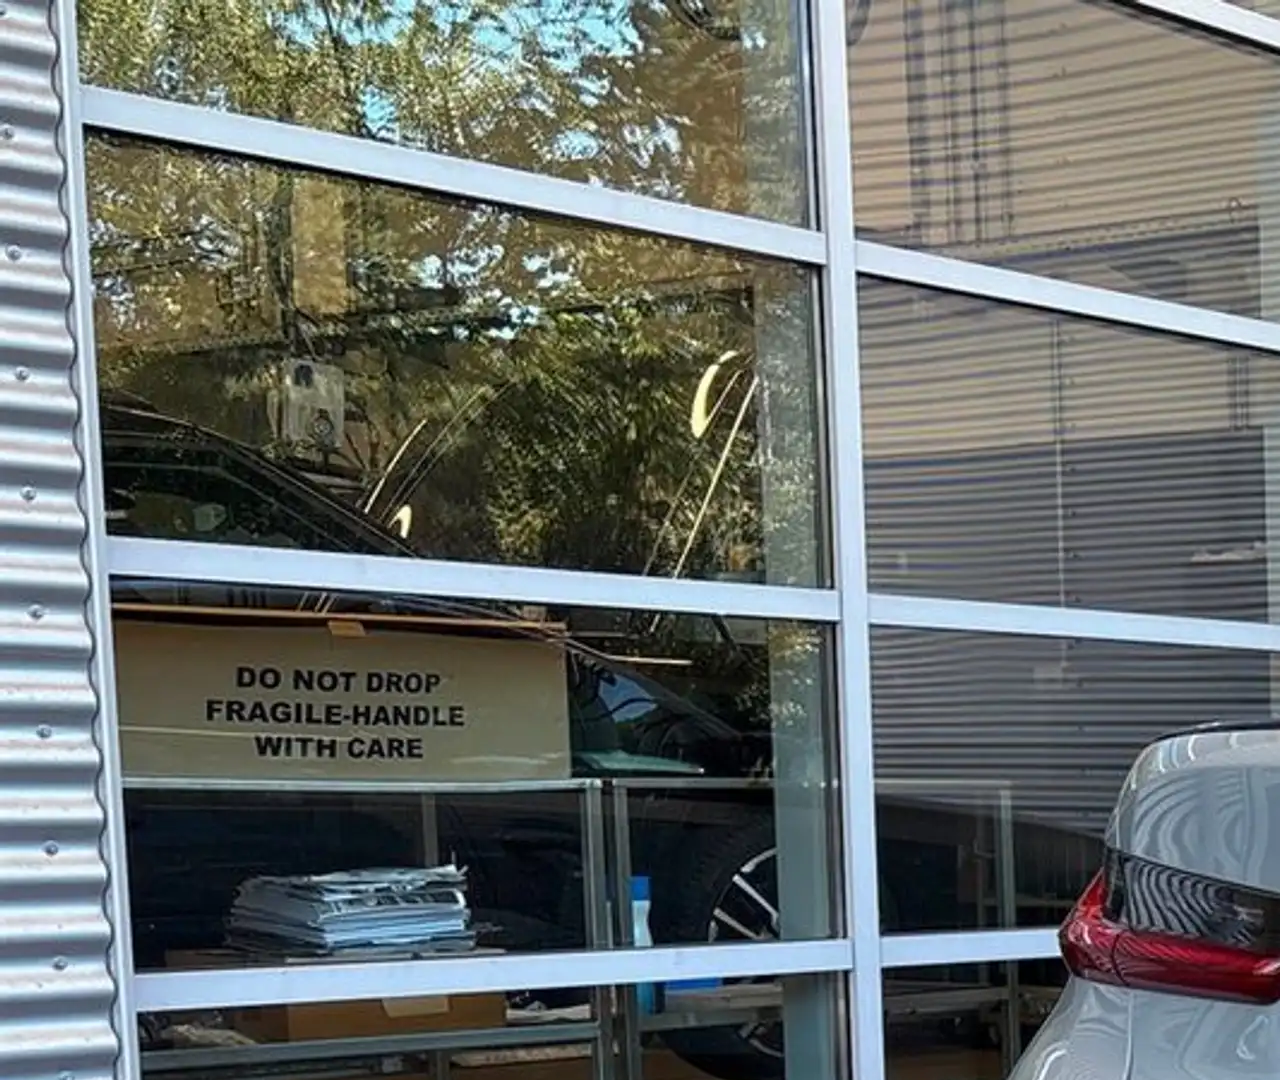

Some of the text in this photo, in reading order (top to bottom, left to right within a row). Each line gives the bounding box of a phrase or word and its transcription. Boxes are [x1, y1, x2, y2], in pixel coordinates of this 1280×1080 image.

[236, 666, 441, 694] DO NOT DROP
[206, 699, 465, 726] FRAGILE-HANDLE
[255, 736, 423, 758] WITH CARE
